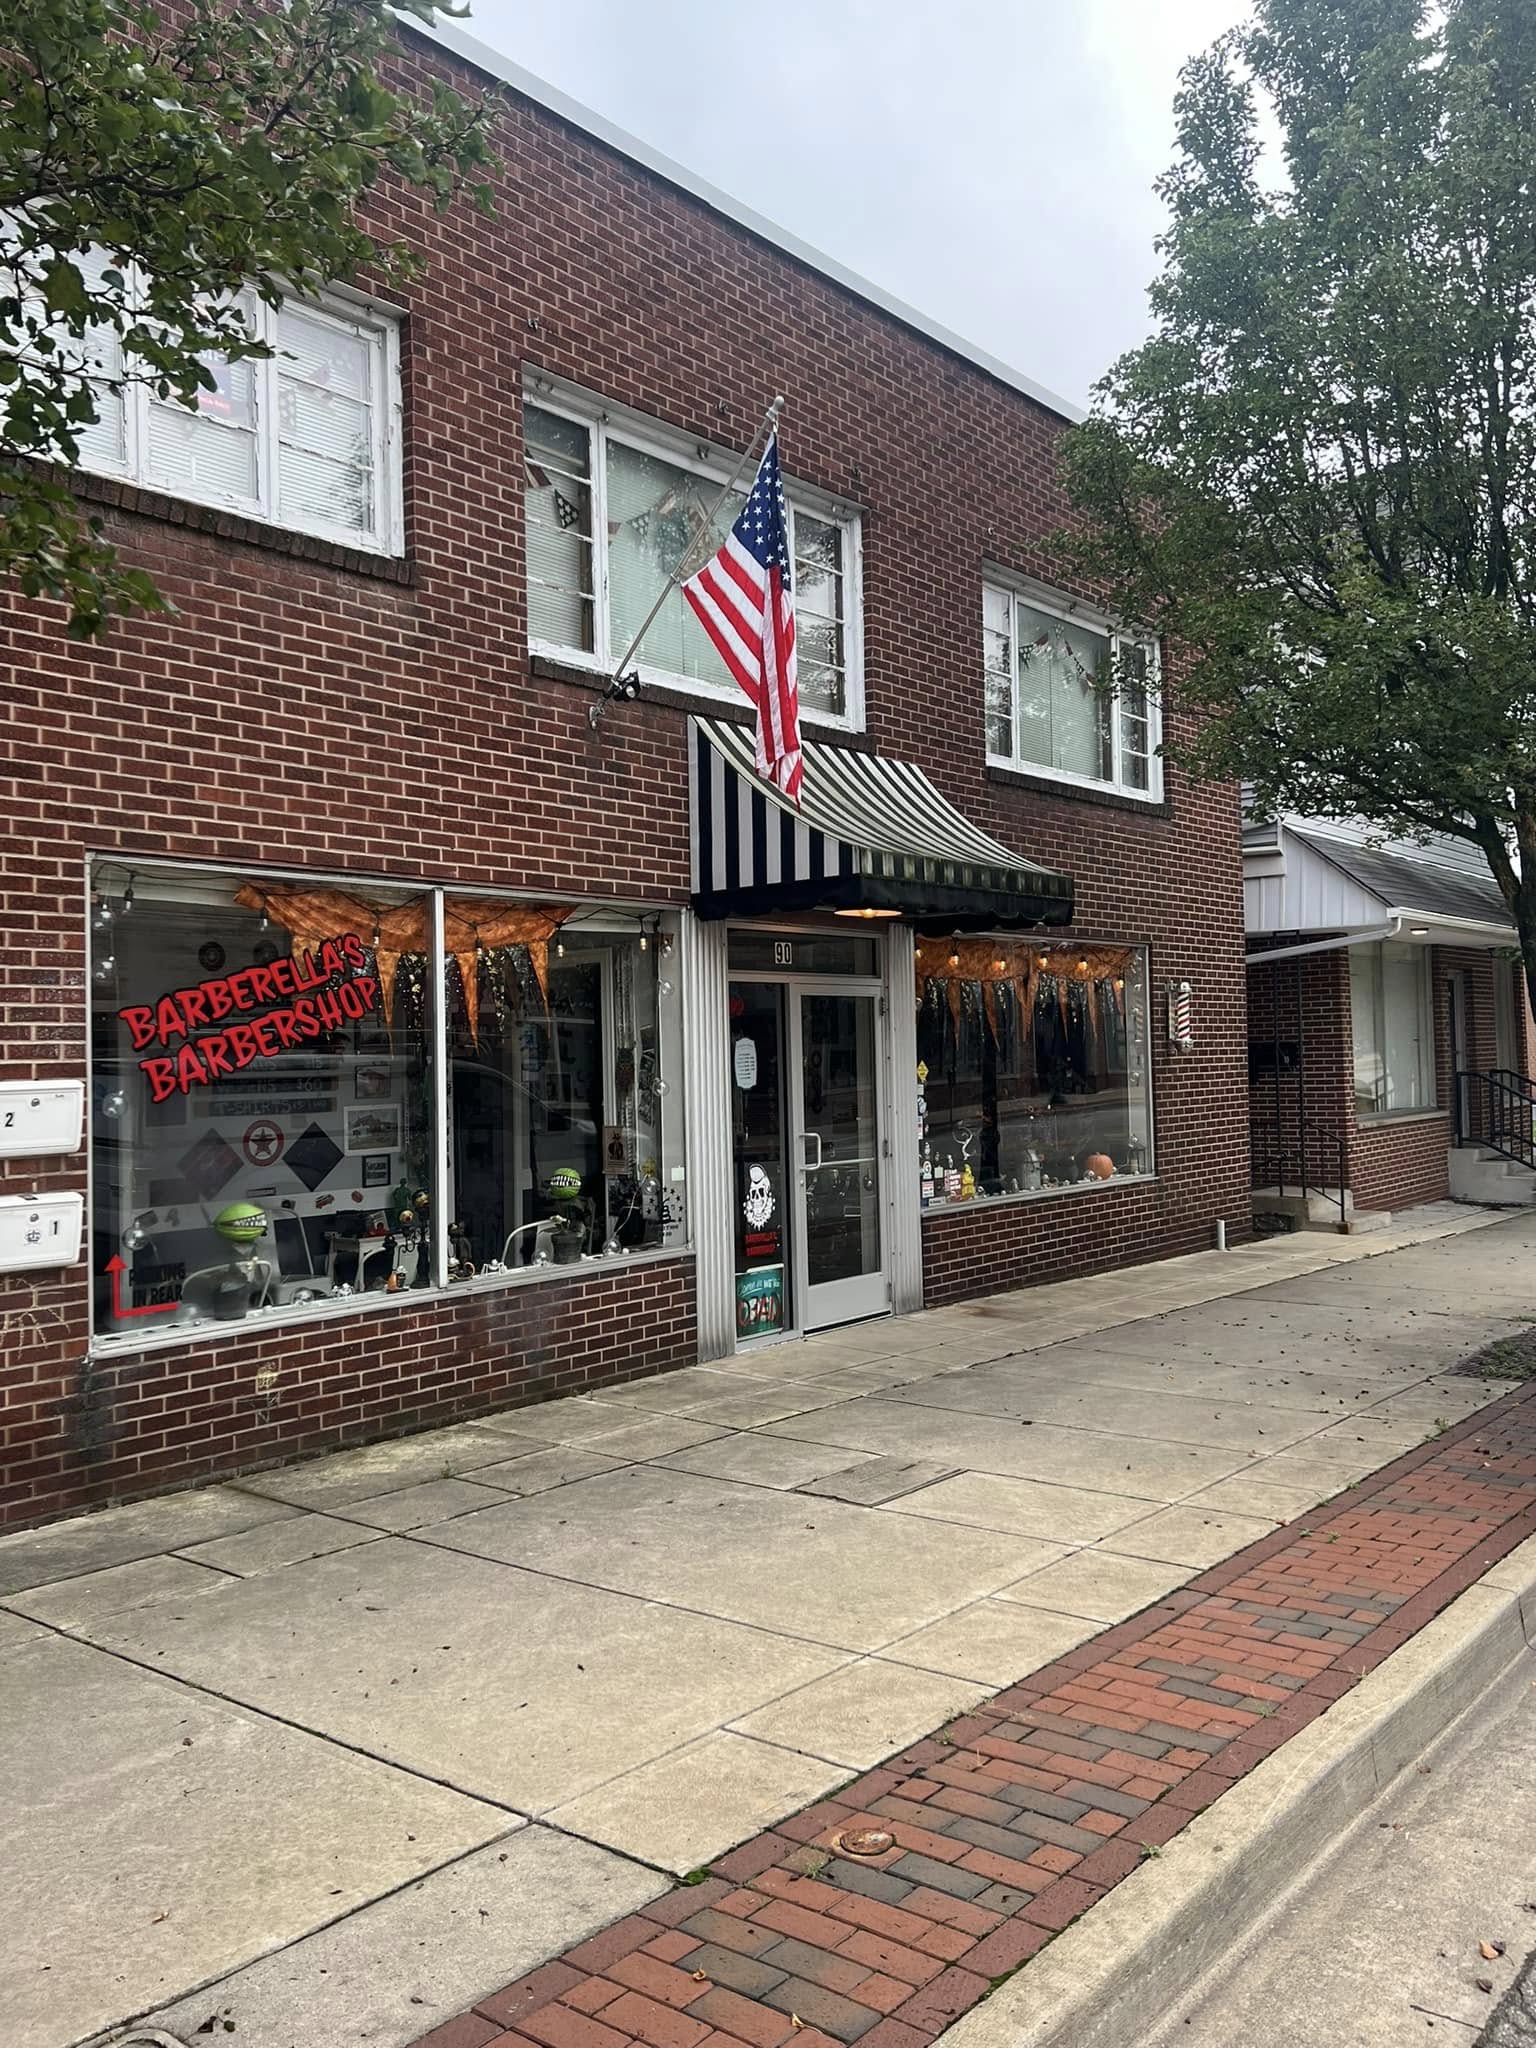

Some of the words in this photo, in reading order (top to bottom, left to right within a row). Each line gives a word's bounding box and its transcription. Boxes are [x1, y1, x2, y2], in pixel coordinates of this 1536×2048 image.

[776, 943, 791, 963] 90
[118, 932, 366, 1050] BARBERELLA'S
[140, 976, 377, 1103] BARBERSHOP
[5, 1112, 14, 1127] 2
[53, 1220, 58, 1236] 1
[151, 1284, 183, 1305] REAR
